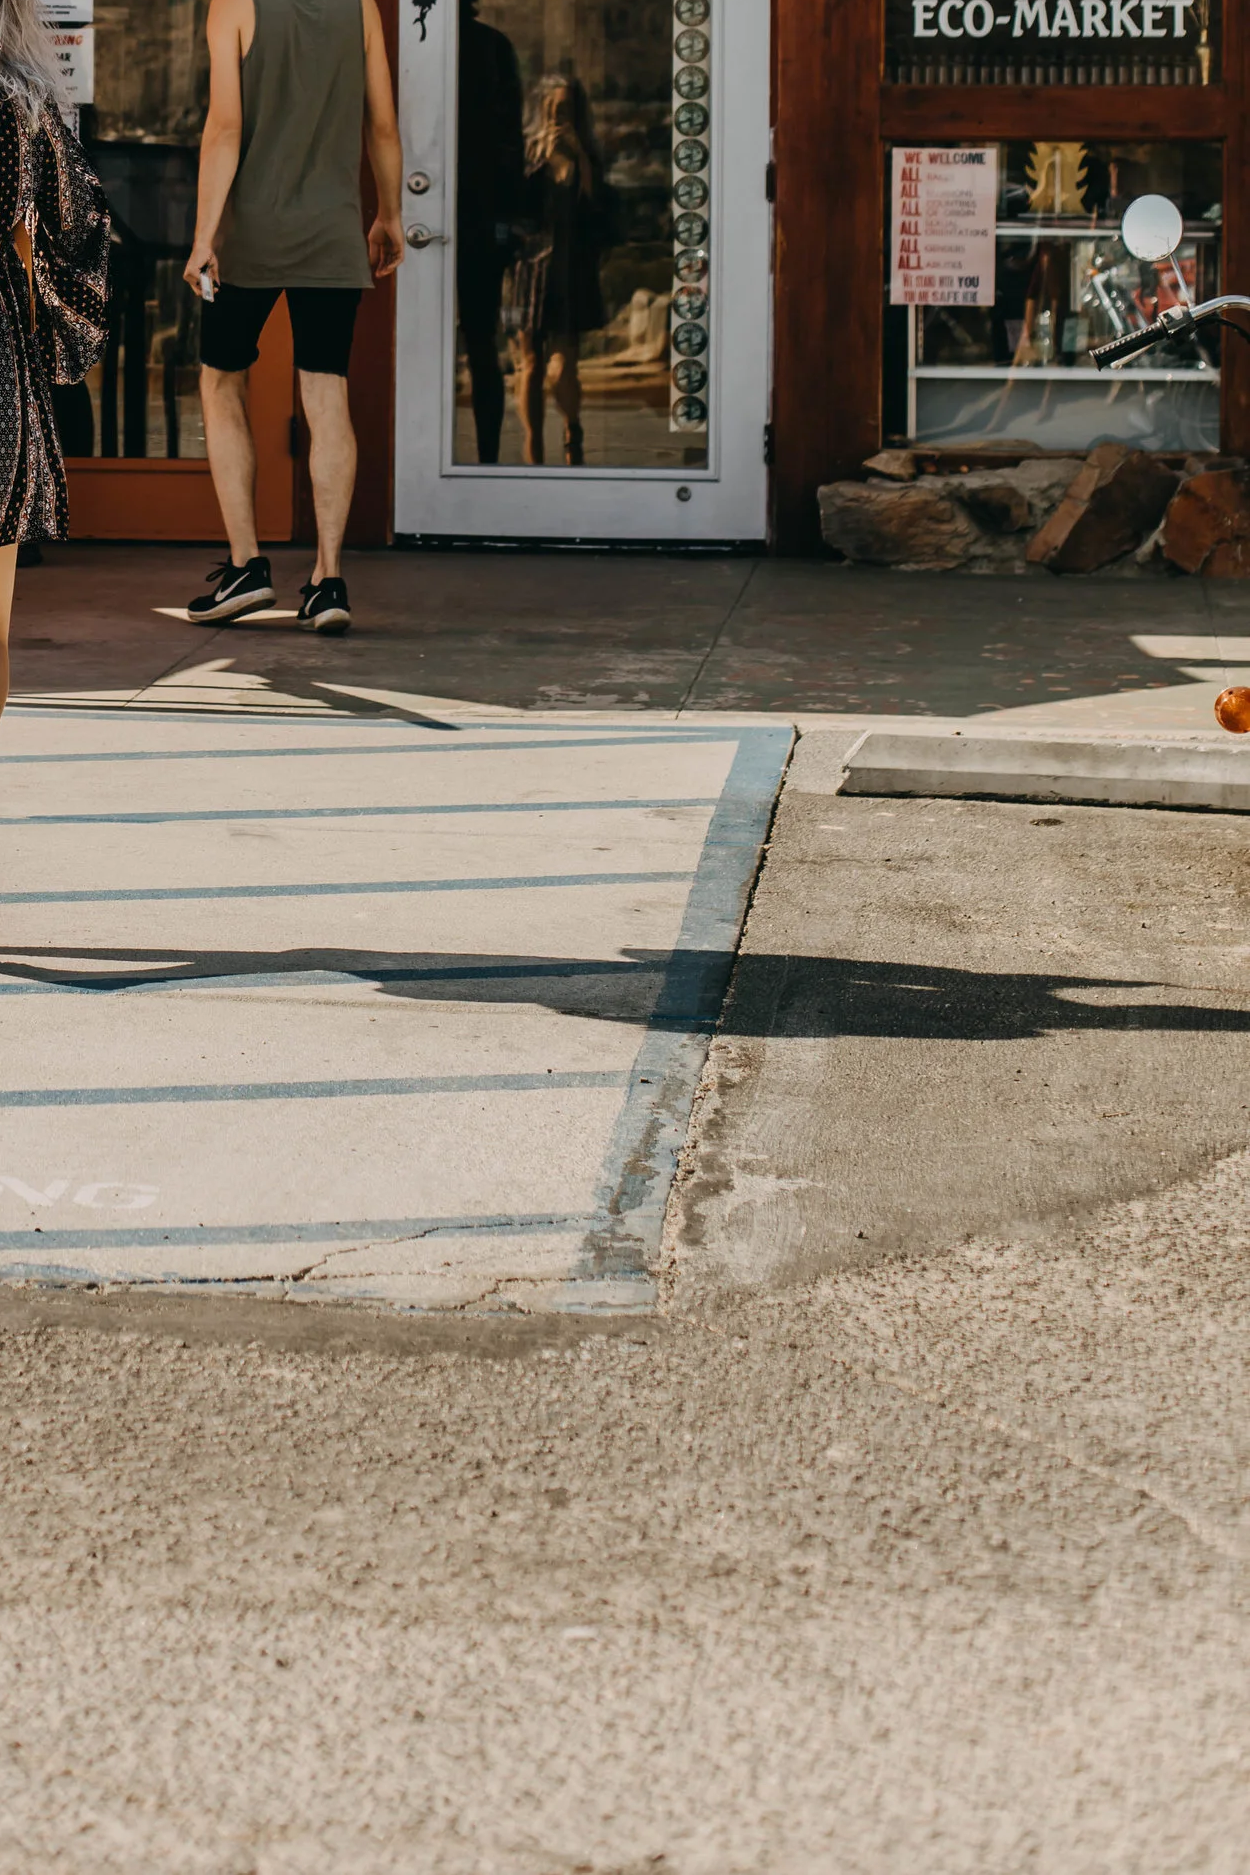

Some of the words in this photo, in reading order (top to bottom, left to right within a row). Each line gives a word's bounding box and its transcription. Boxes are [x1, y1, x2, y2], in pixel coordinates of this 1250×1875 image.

[903, 151, 922, 164] WE
[928, 151, 986, 165] WELCOME
[901, 167, 922, 182] ALL
[901, 183, 921, 198] ALL
[901, 201, 922, 217] ALL
[900, 220, 921, 236] ALL
[900, 238, 920, 253] ALL
[898, 255, 923, 270] ALL
[957, 275, 980, 289] YOU
[931, 290, 961, 304] SAFE
